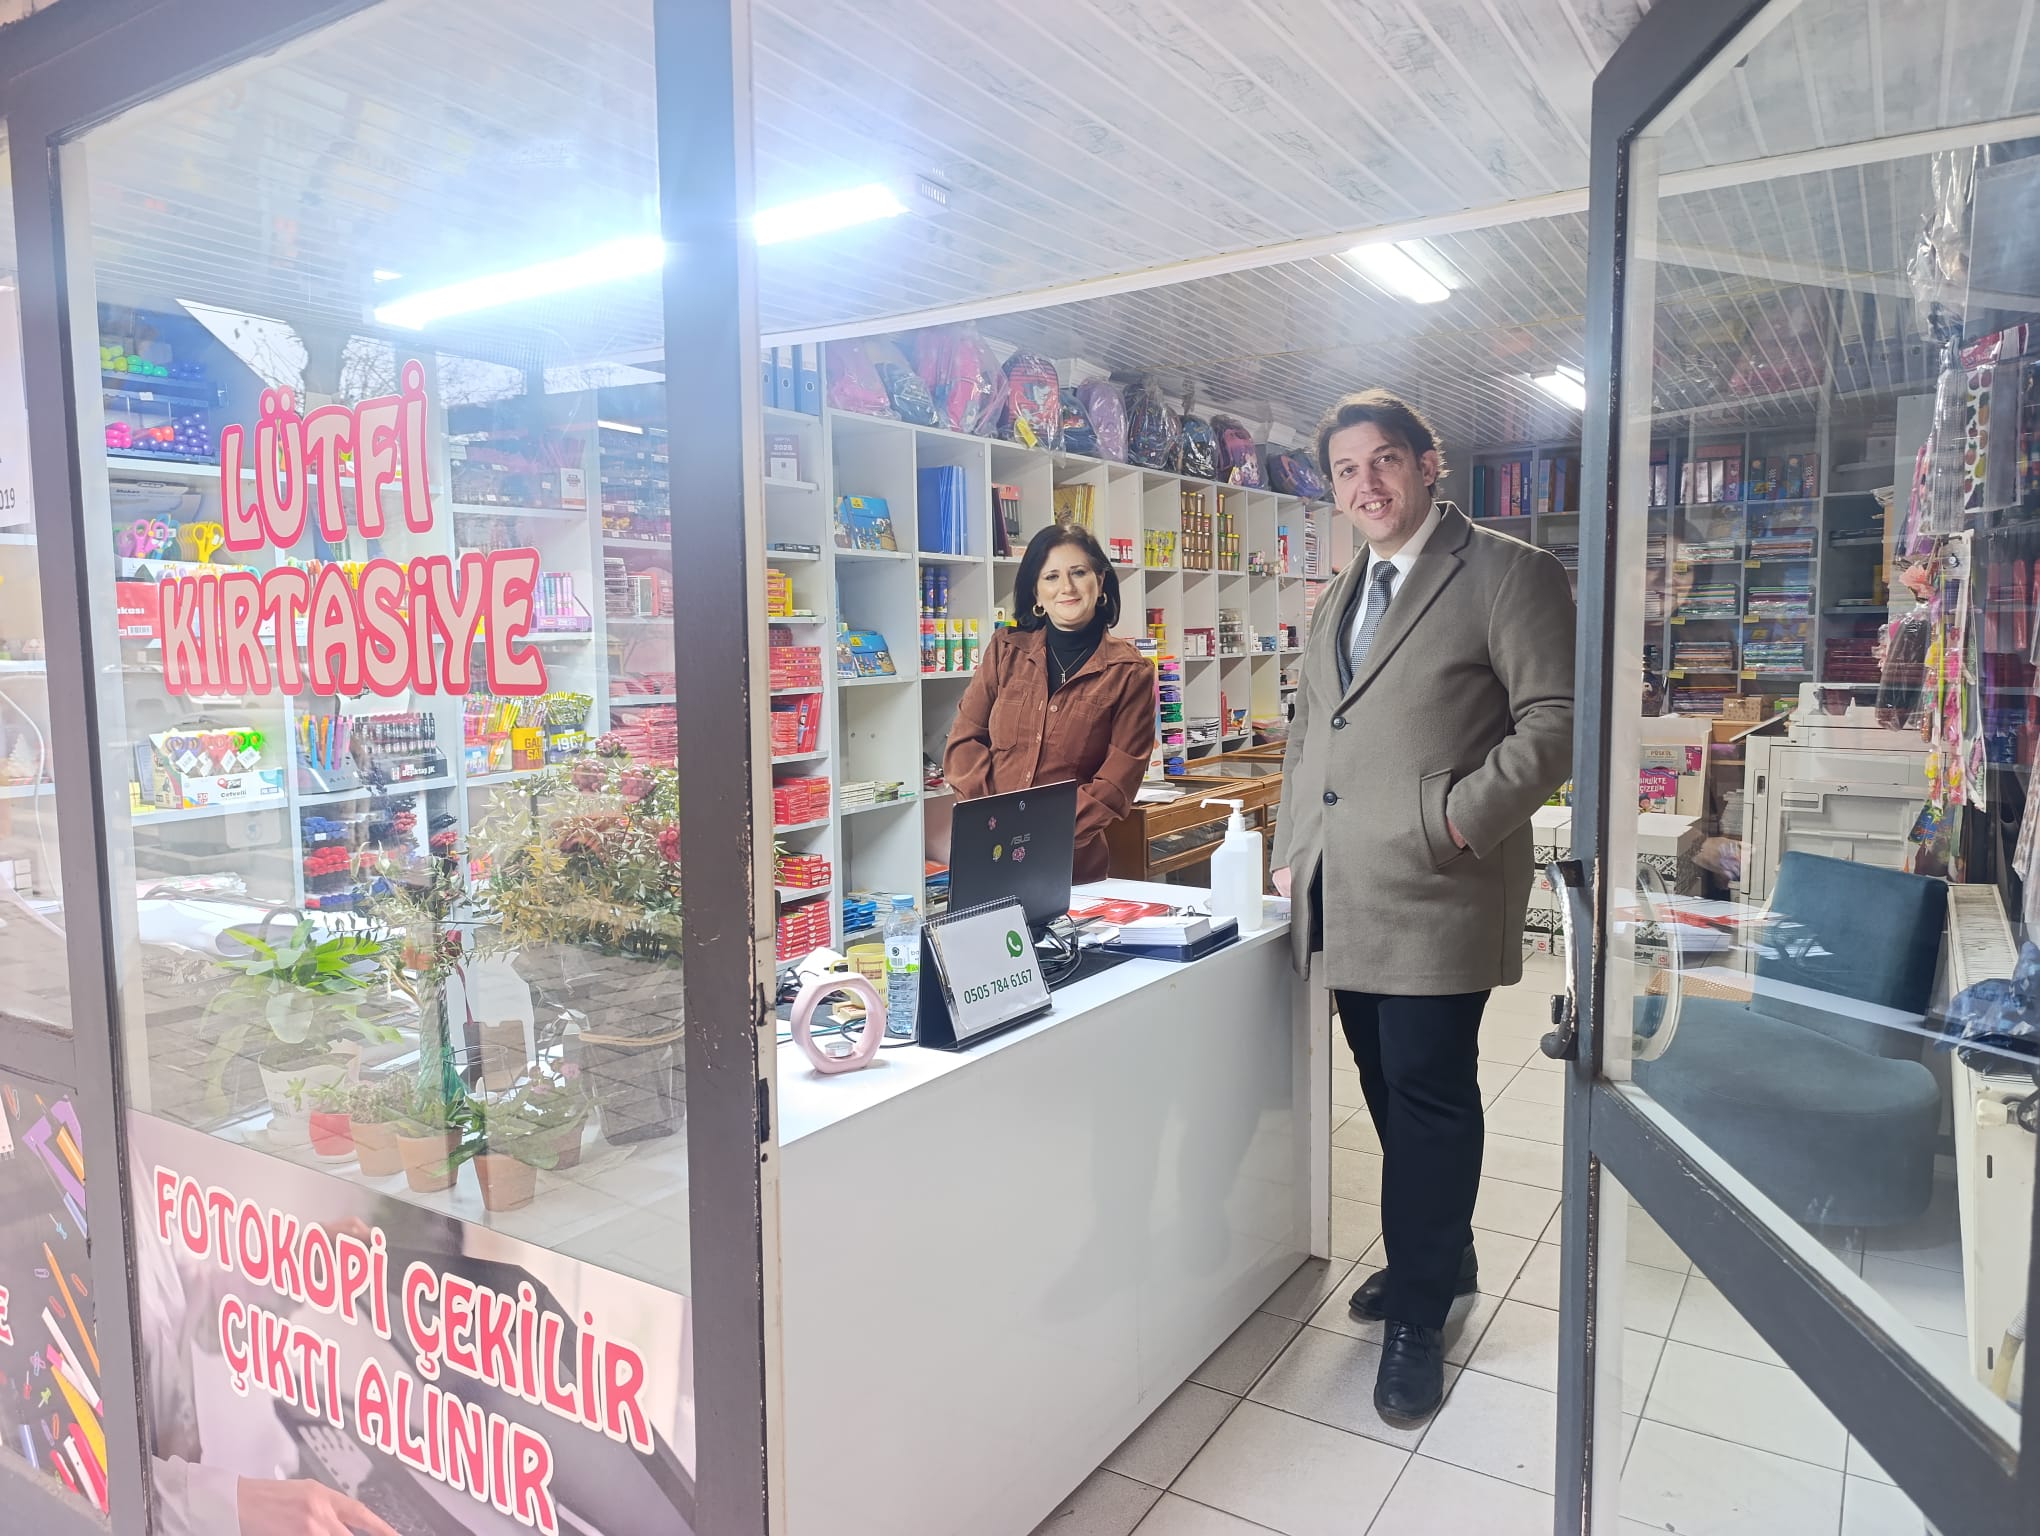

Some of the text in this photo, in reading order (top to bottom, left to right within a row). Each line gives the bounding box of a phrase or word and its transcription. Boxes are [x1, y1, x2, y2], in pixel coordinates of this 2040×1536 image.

[222, 359, 433, 552] LÜTFİ
[1011, 833, 1031, 846] ASUS
[964, 968, 1033, 1005] 0505 784 6167
[154, 1164, 655, 1455] FOTOKOPİ ÇEKİLİR
[218, 1294, 559, 1536] ÇIKTI ALINIR
